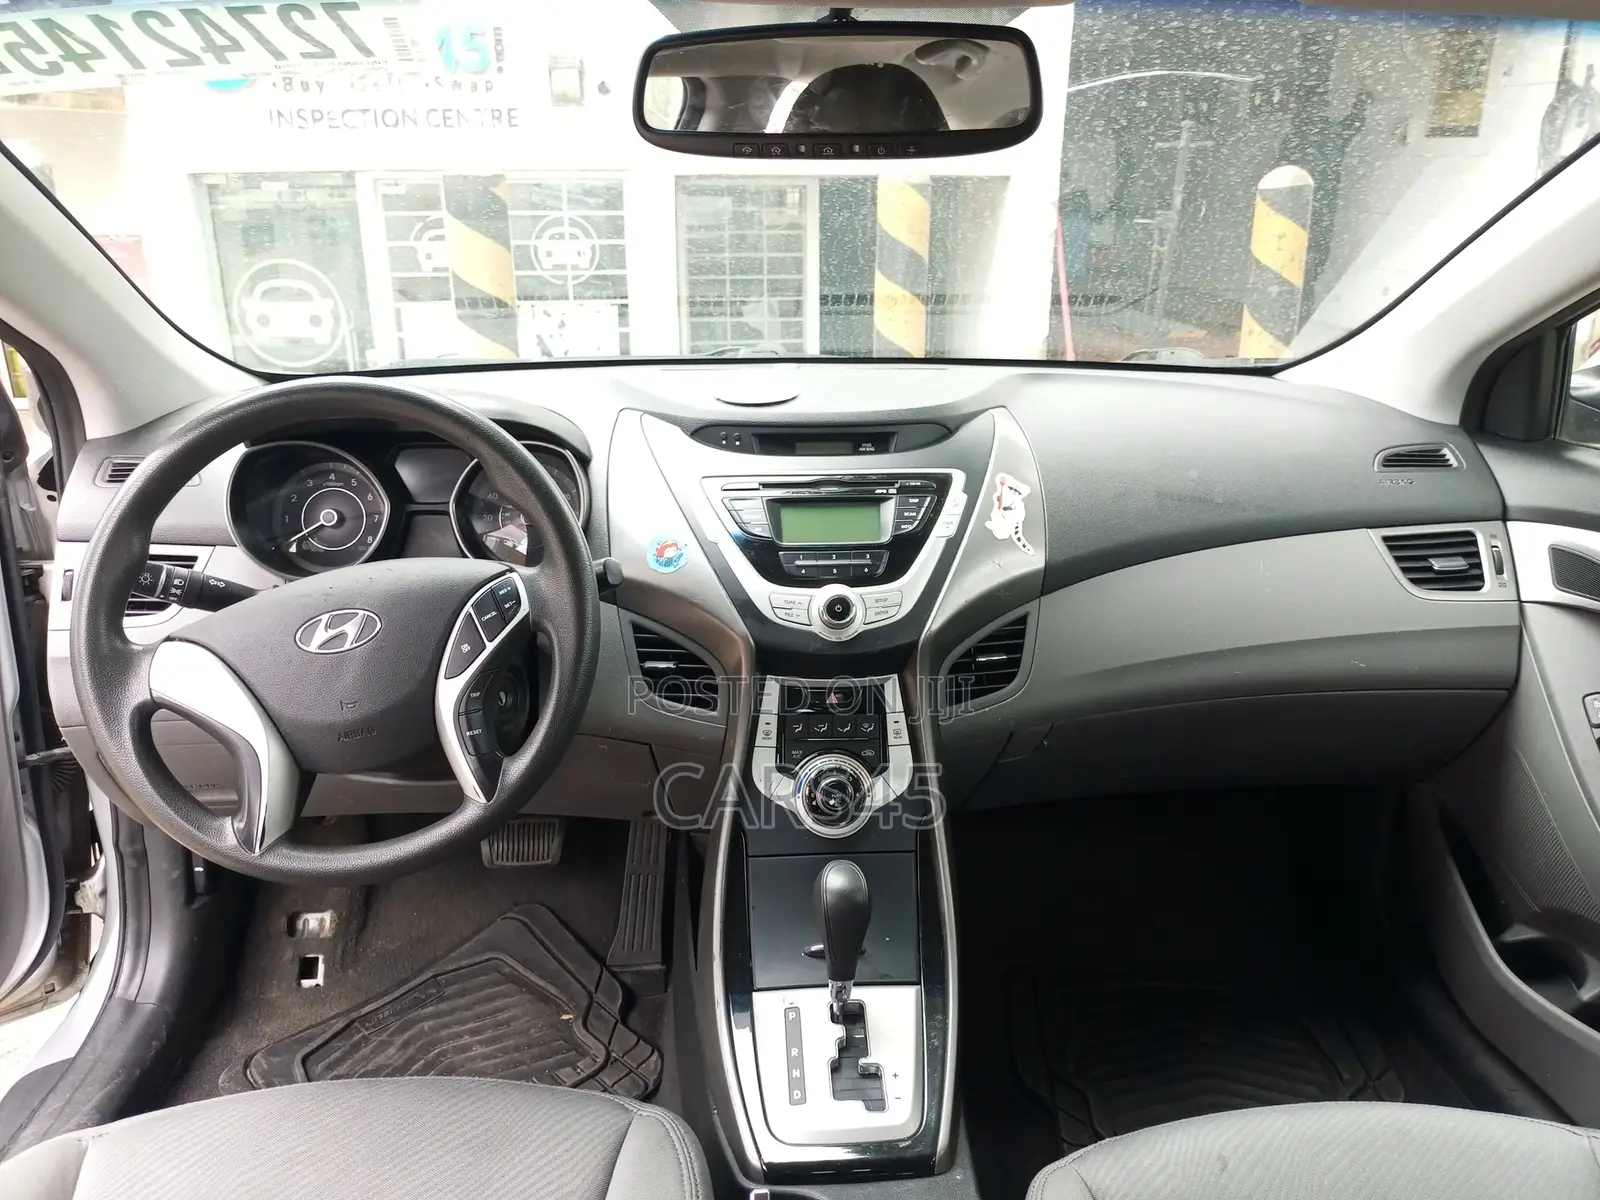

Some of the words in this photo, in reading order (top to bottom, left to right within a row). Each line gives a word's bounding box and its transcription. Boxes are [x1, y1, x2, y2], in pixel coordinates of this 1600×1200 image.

[268, 107, 419, 131] INSPECTION
[425, 107, 520, 130] CENTRE
[337, 725, 378, 743] AIRBAG
[466, 728, 482, 737] RESET
[789, 1012, 796, 1021] P
[791, 1048, 799, 1056] R
[792, 1070, 800, 1078] N
[793, 1091, 801, 1099] D
